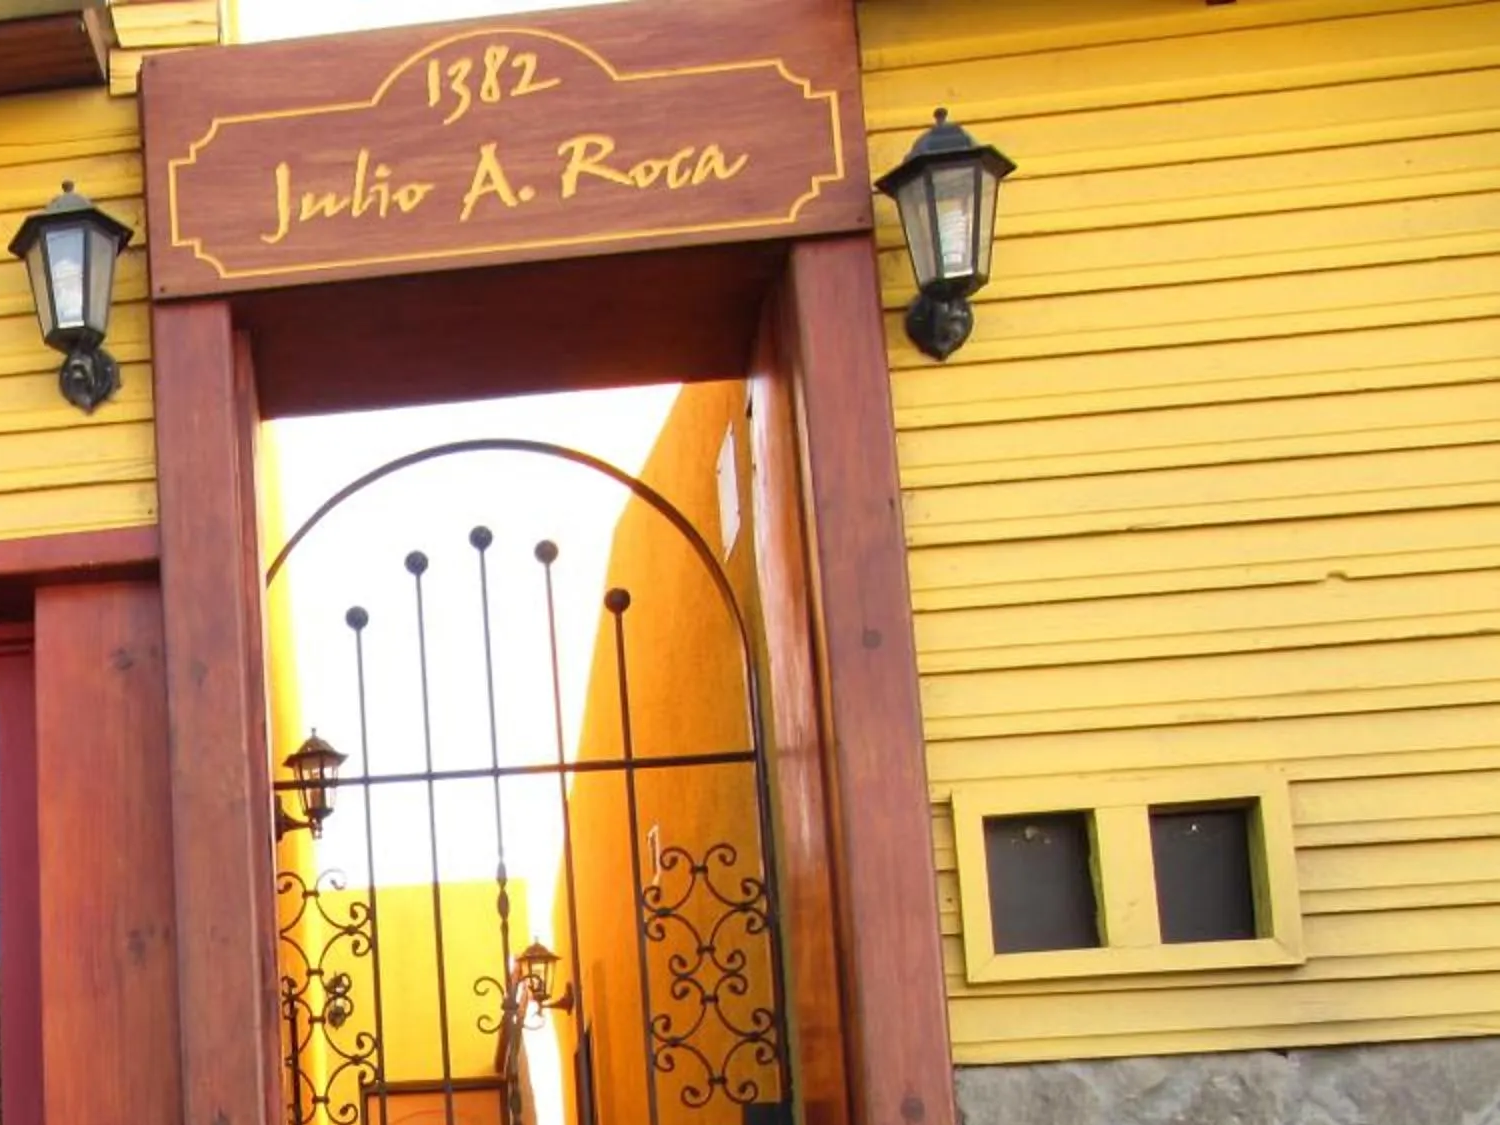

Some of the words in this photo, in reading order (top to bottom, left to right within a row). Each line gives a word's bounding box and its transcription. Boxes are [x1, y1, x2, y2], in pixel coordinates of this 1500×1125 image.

[426, 45, 562, 126] 1382
[260, 147, 436, 244] Julio
[459, 142, 535, 221] A.
[556, 132, 751, 198] Roca
